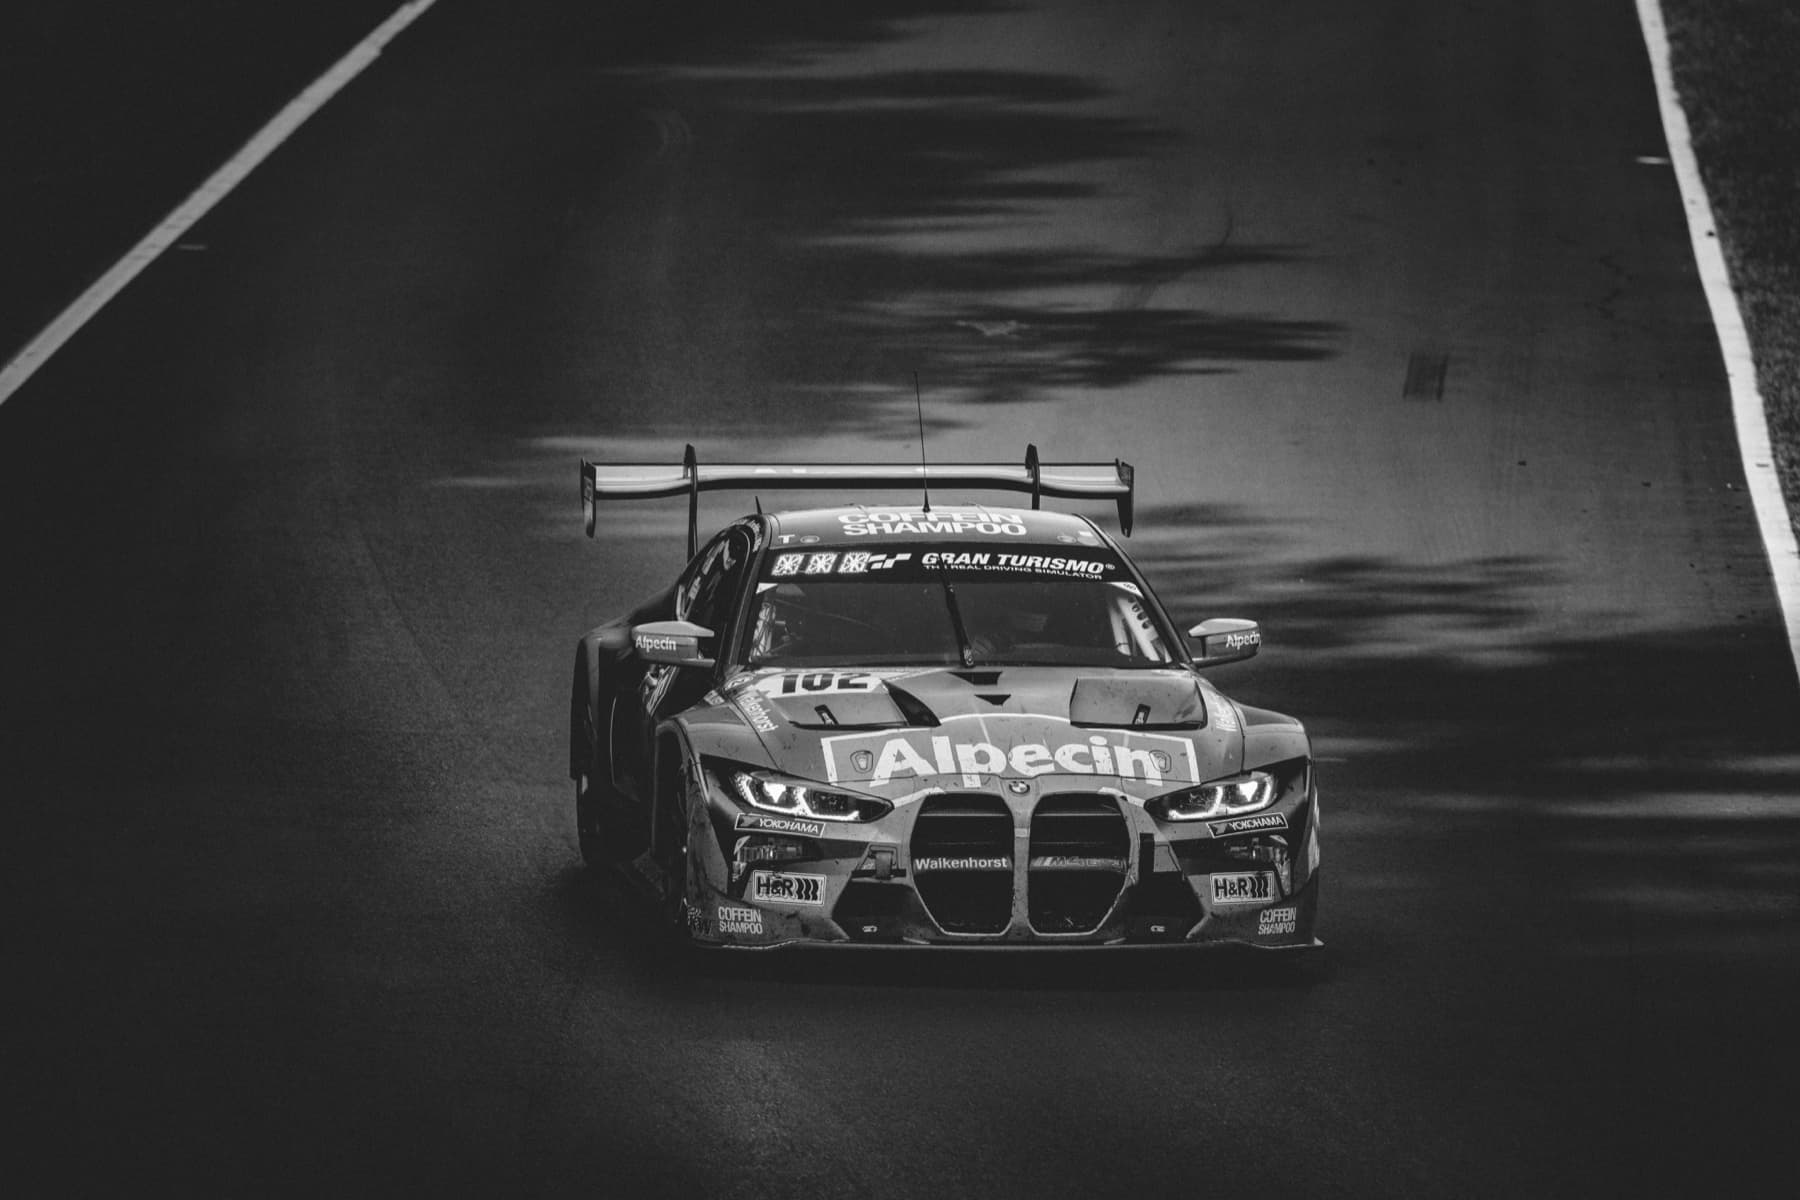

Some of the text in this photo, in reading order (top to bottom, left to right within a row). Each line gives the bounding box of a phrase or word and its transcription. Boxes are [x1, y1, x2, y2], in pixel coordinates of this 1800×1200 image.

[838, 512, 1023, 524] COFFEIN
[843, 522, 1027, 536] SHAMPOO
[922, 553, 990, 565] GRAN
[984, 565, 1031, 573] DRIVING
[1035, 569, 1102, 580] SIMULATOR
[635, 635, 676, 653] Alpecin
[782, 673, 871, 694] 102
[869, 735, 1163, 788] Alpecin
[758, 818, 819, 834] YOKOHAMA
[1228, 815, 1284, 831] YOKOHAMA
[915, 857, 1008, 869] Walkenhorst
[757, 876, 794, 896] H&R
[1213, 877, 1249, 897] H&R
[718, 906, 762, 923] COFFEIN
[1260, 907, 1296, 923] COFFEIN
[719, 921, 763, 934] SHAMPOO
[1258, 921, 1296, 935] SHAMPOO
